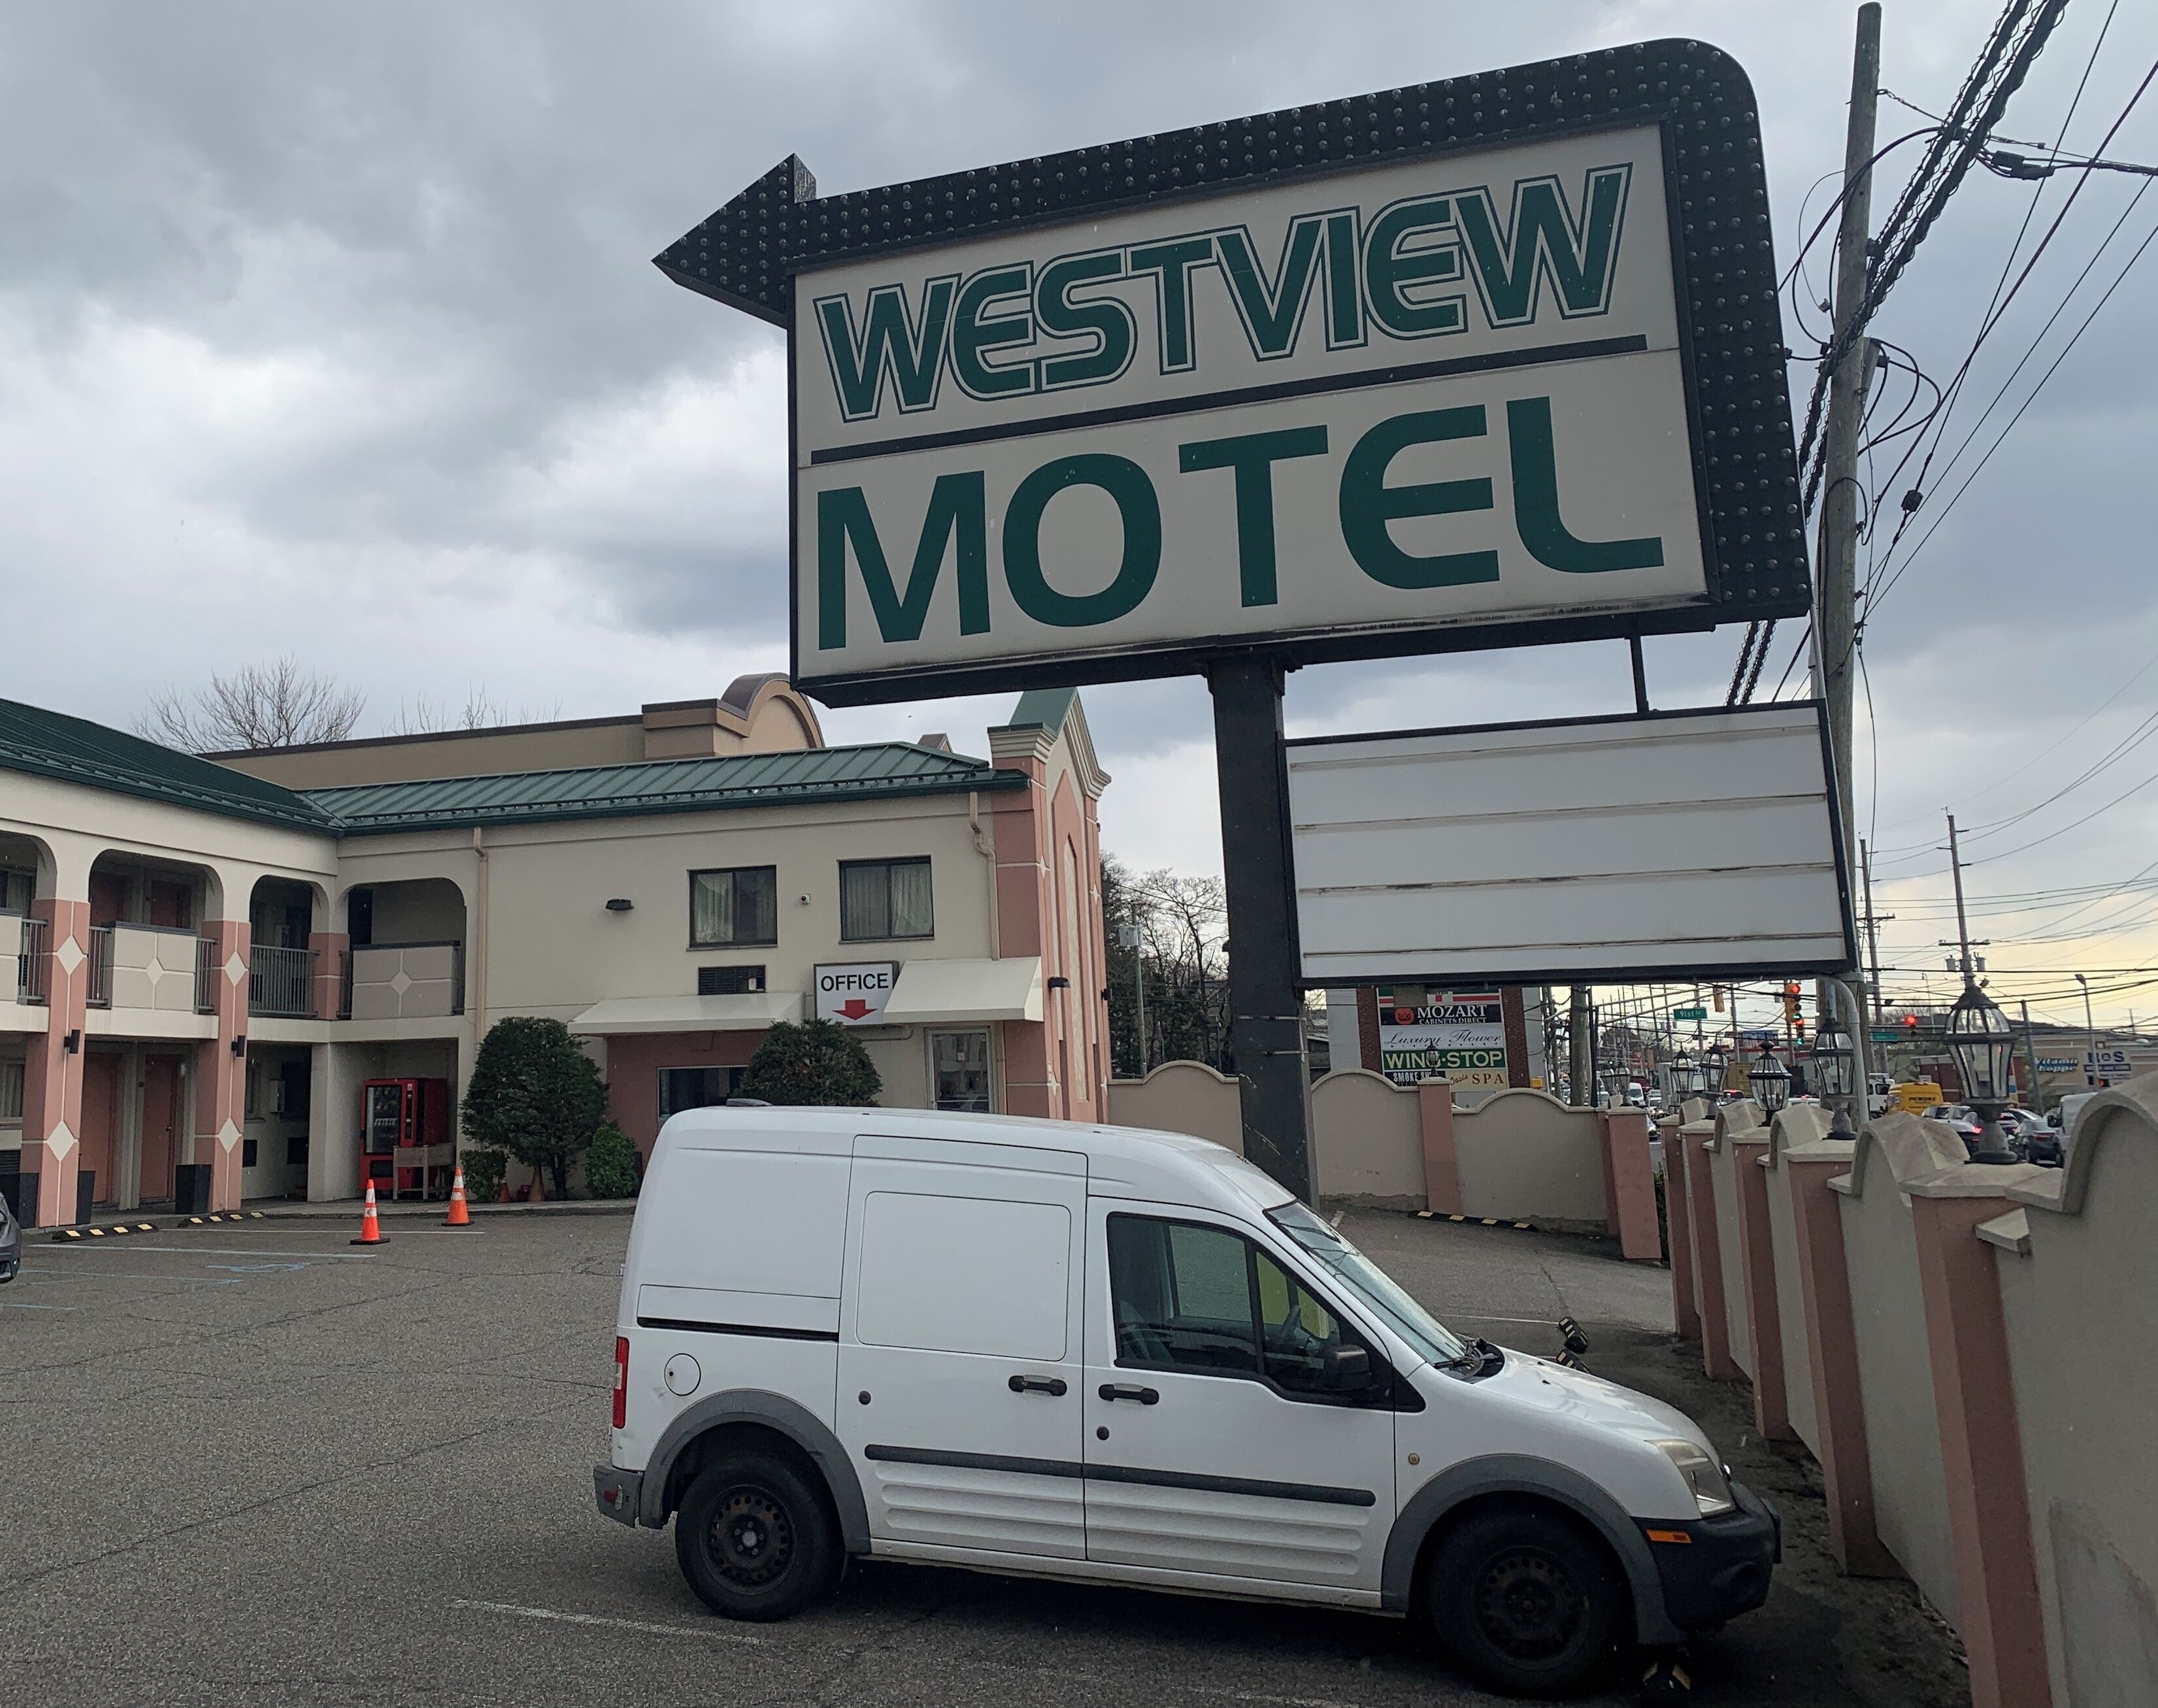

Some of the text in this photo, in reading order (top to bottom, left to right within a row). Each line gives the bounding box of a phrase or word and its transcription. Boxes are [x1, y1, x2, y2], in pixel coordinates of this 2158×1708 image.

[812, 161, 1633, 423] WESTVIEW
[817, 396, 1665, 650] MOTEL
[821, 973, 888, 991] OFFICE
[1417, 1004, 1487, 1019] MOZART
[1384, 1029, 1501, 1044] Luxury Flower
[1393, 1072, 1419, 1083] SMOKE
[1450, 1073, 1504, 1085] Oasis SPA
